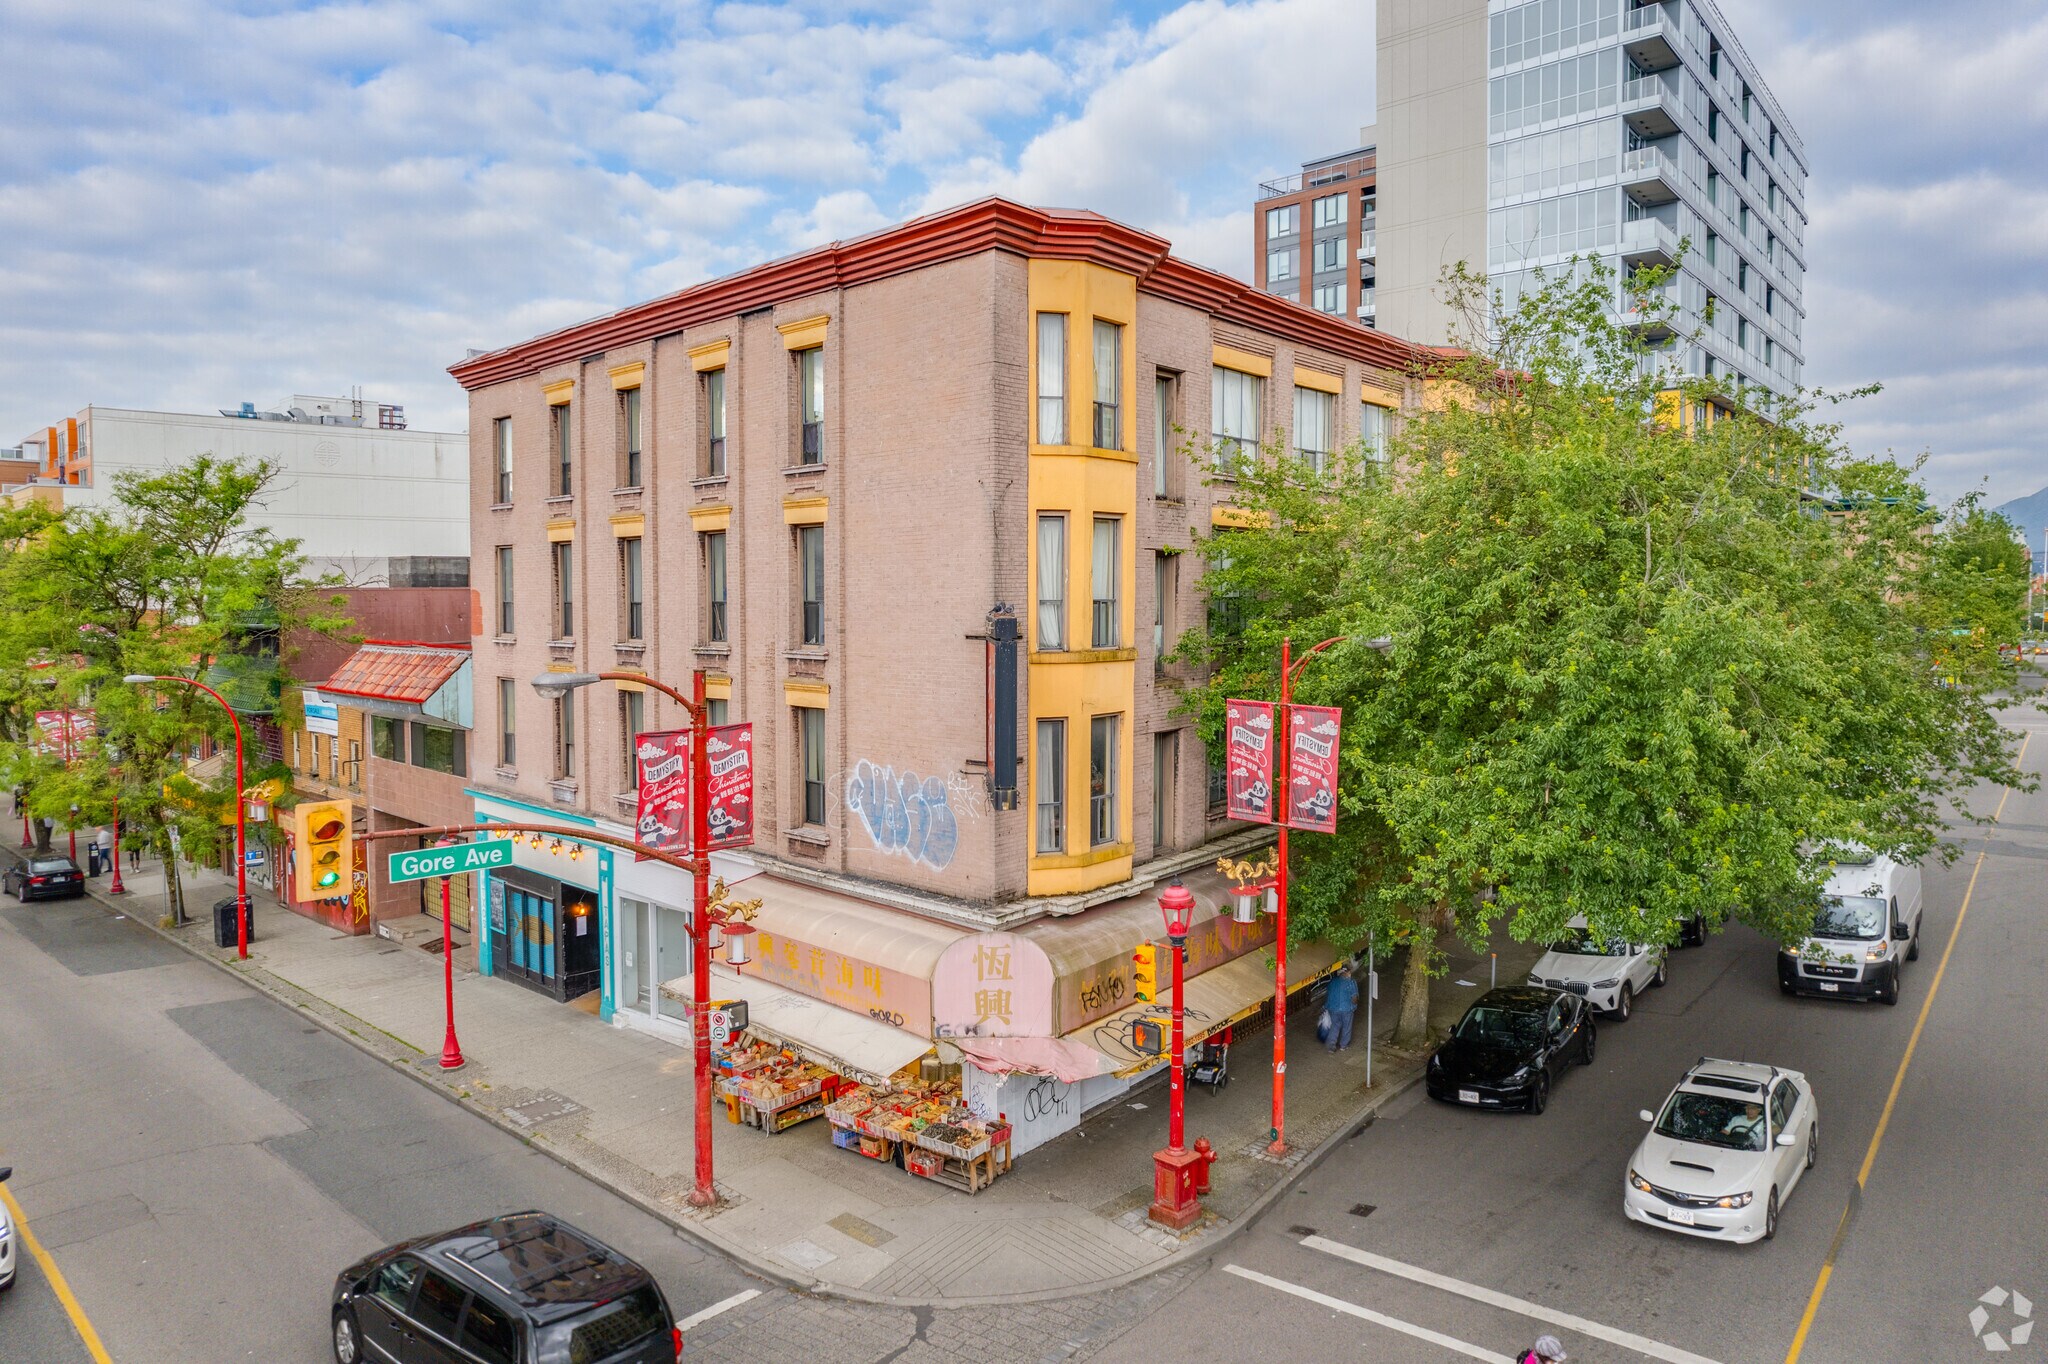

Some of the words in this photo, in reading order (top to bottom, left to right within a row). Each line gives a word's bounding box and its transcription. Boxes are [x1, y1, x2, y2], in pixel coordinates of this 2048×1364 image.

[648, 757, 681, 781] DEMYSTIFY
[713, 752, 745, 775] DEMYSTIFY
[642, 776, 687, 801] Chinatown
[708, 770, 752, 793] Chinatown
[401, 855, 456, 876] Gore
[465, 848, 503, 867] Ave
[971, 943, 1014, 1027] 恆興
